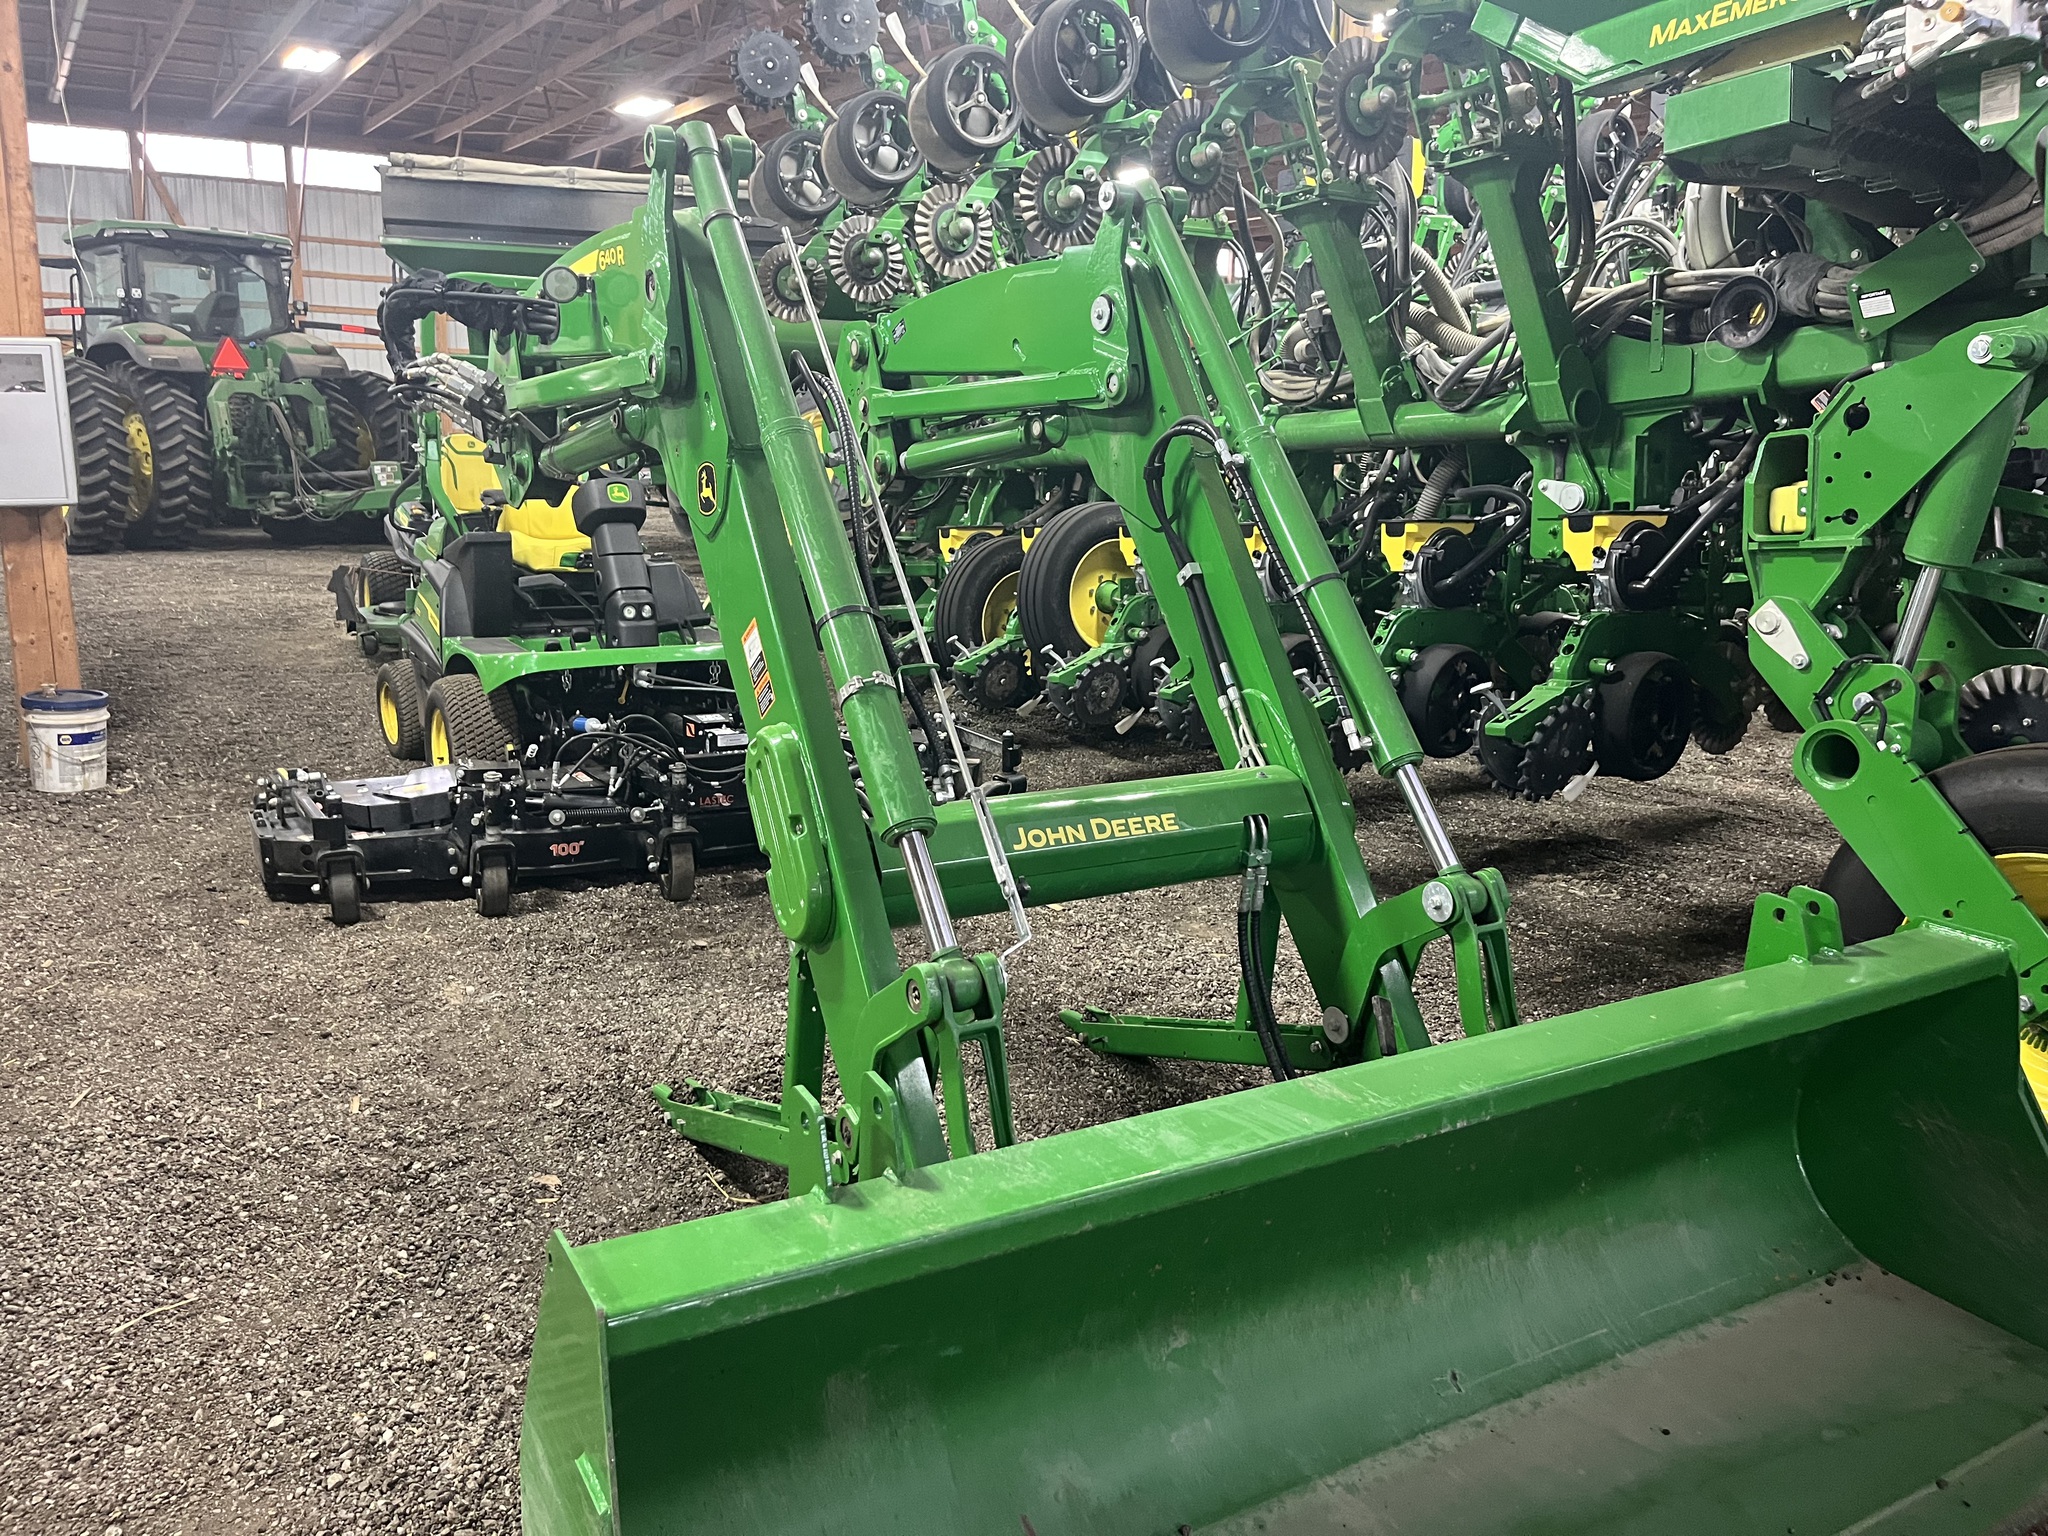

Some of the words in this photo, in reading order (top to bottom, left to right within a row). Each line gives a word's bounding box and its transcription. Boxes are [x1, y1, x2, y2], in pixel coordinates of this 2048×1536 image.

[1649, 0, 1799, 48] MAXEMER
[598, 245, 625, 271] 640R
[1013, 823, 1087, 851] JOHN
[1089, 812, 1180, 840] DEERE
